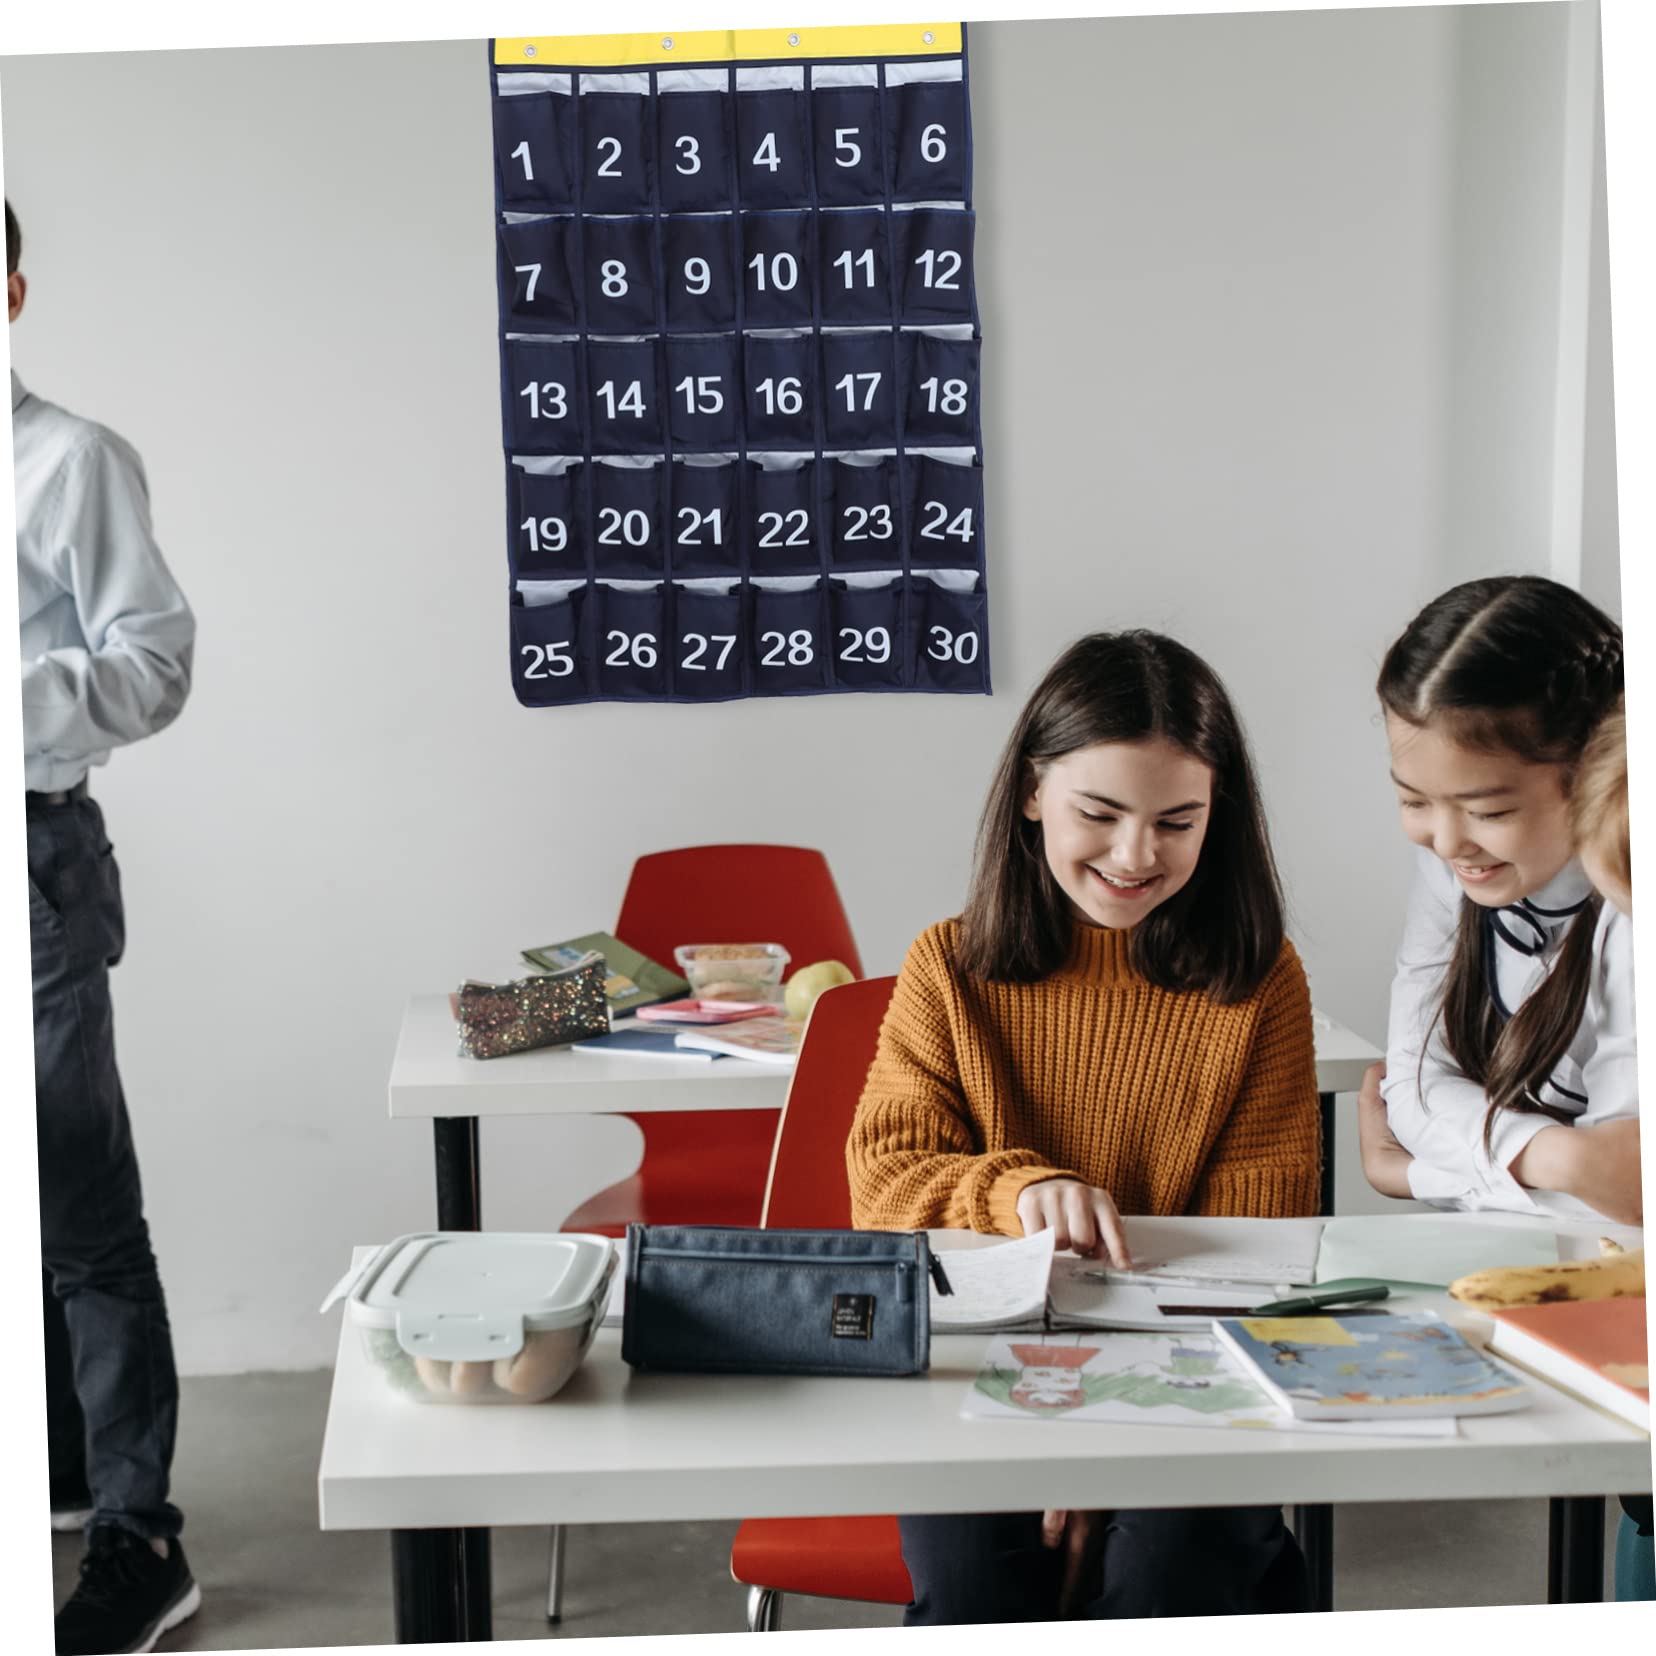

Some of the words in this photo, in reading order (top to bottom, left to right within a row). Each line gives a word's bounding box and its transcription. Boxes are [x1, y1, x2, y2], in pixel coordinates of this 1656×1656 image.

[511, 141, 534, 181] 1
[597, 137, 622, 177] 2
[675, 135, 701, 175] 3
[752, 132, 781, 172] 4
[835, 127, 861, 168] 5
[920, 123, 947, 163] 6
[515, 263, 542, 301] 7
[601, 259, 628, 298] 8
[684, 257, 711, 295] 9
[749, 252, 798, 291] 10
[833, 248, 875, 289] 11
[915, 249, 962, 290] 12
[520, 381, 568, 419] 13
[596, 380, 647, 419] 14
[675, 376, 724, 414] 15
[755, 377, 803, 415] 16
[835, 372, 882, 412] 17
[920, 377, 968, 415] 18
[520, 516, 567, 551] 19
[598, 507, 650, 546] 20
[677, 507, 722, 545] 21
[758, 509, 810, 548] 22
[843, 504, 893, 541] 23
[920, 501, 974, 543] 24
[521, 640, 574, 679] 25
[605, 630, 657, 668] 26
[681, 633, 737, 671] 27
[761, 629, 814, 666] 28
[839, 626, 891, 663] 29
[927, 625, 978, 664] 30
